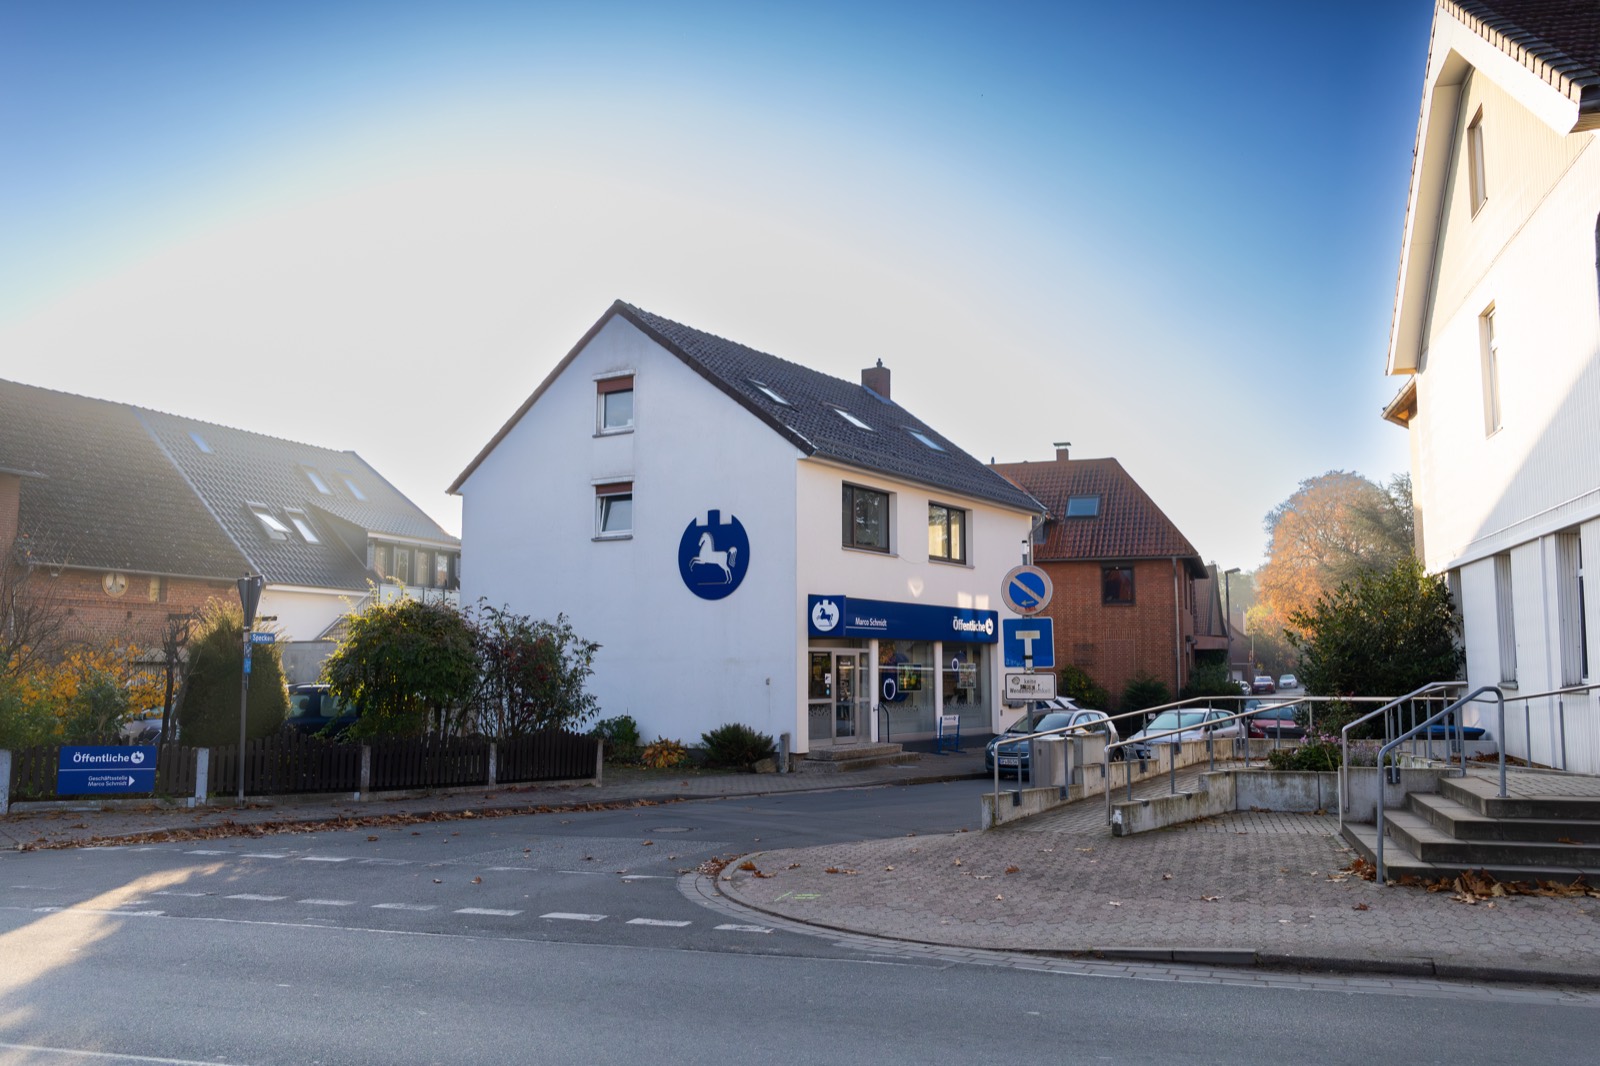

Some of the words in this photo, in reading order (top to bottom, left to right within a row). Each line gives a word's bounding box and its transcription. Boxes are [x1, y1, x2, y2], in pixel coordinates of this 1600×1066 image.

[855, 617, 869, 626] Marco
[869, 618, 887, 627] Schmidt
[953, 616, 986, 632] Öffentliche
[252, 633, 274, 643] Specken
[73, 752, 130, 763] Öffentliche
